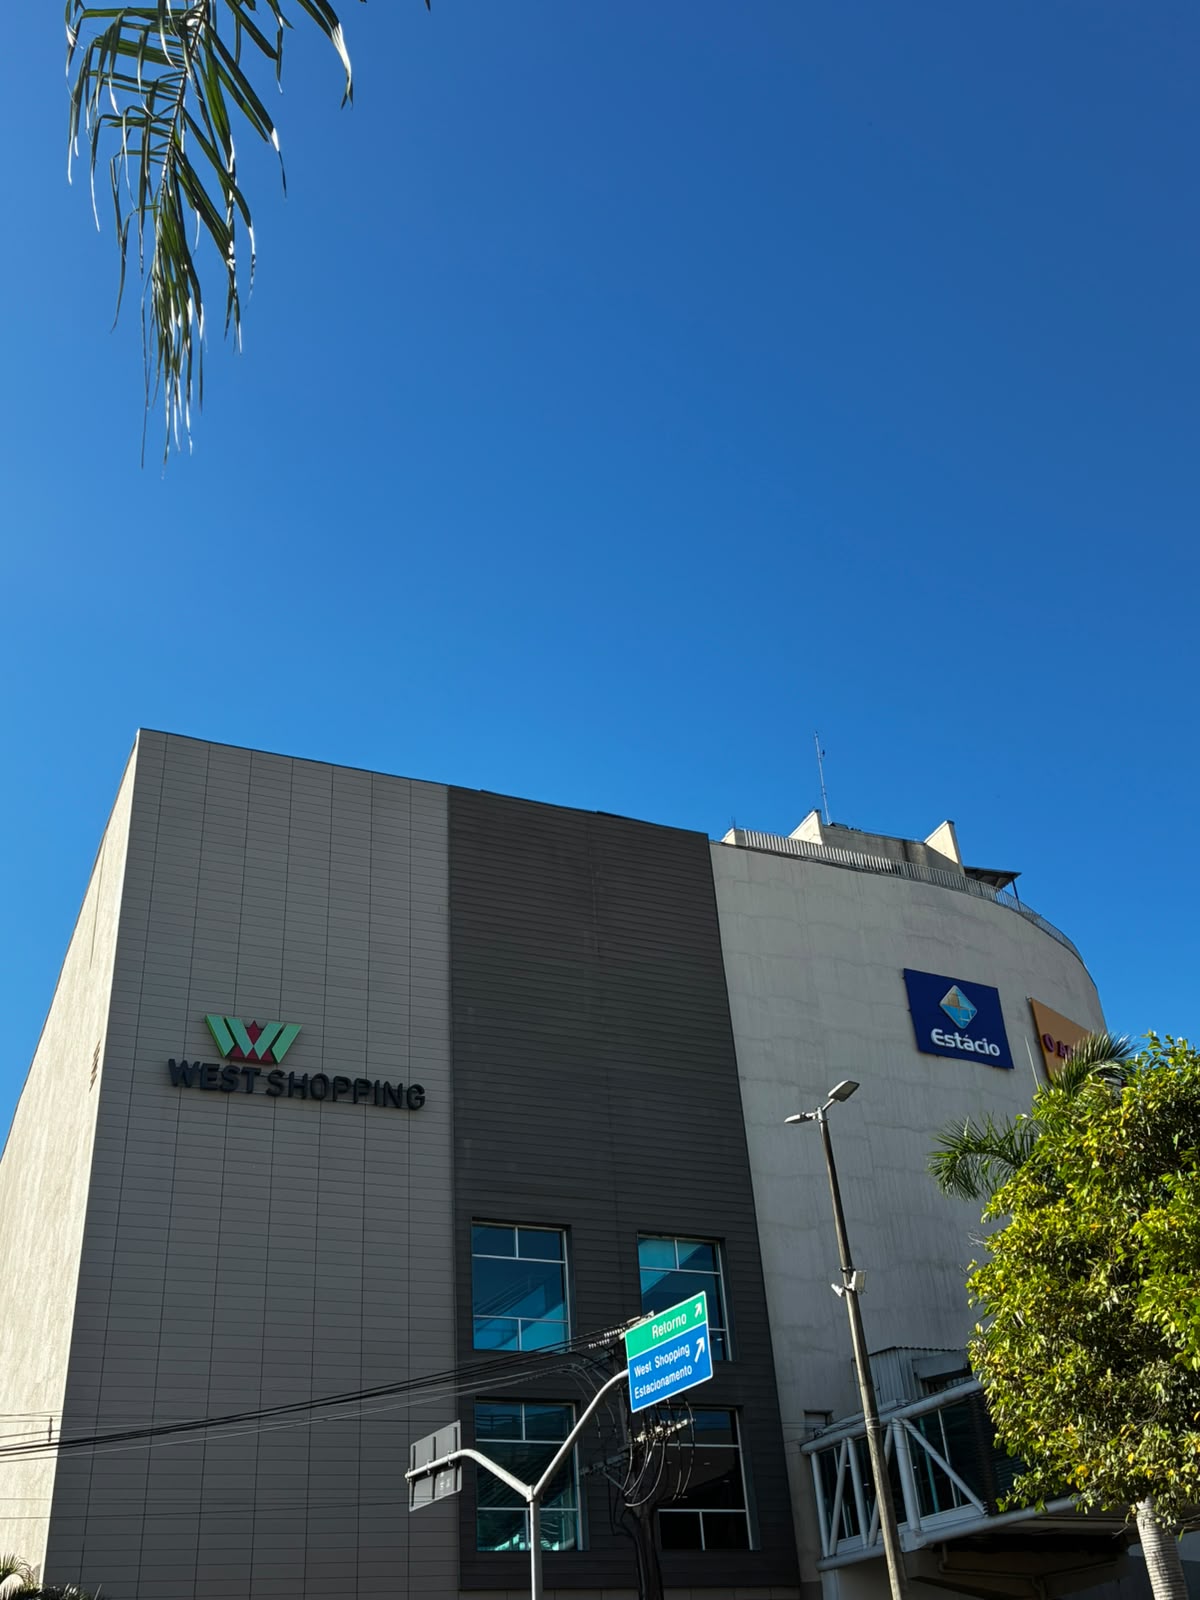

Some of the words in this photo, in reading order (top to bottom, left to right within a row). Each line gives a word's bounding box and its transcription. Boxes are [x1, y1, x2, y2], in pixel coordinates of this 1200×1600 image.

[931, 1028, 1000, 1057] Estácio
[168, 1058, 261, 1094] WEST
[266, 1069, 426, 1110] SHOPPING
[651, 1313, 687, 1339] Retorno
[634, 1360, 652, 1378] West
[654, 1344, 690, 1369] Shopping
[634, 1365, 693, 1399] Estacionamento
